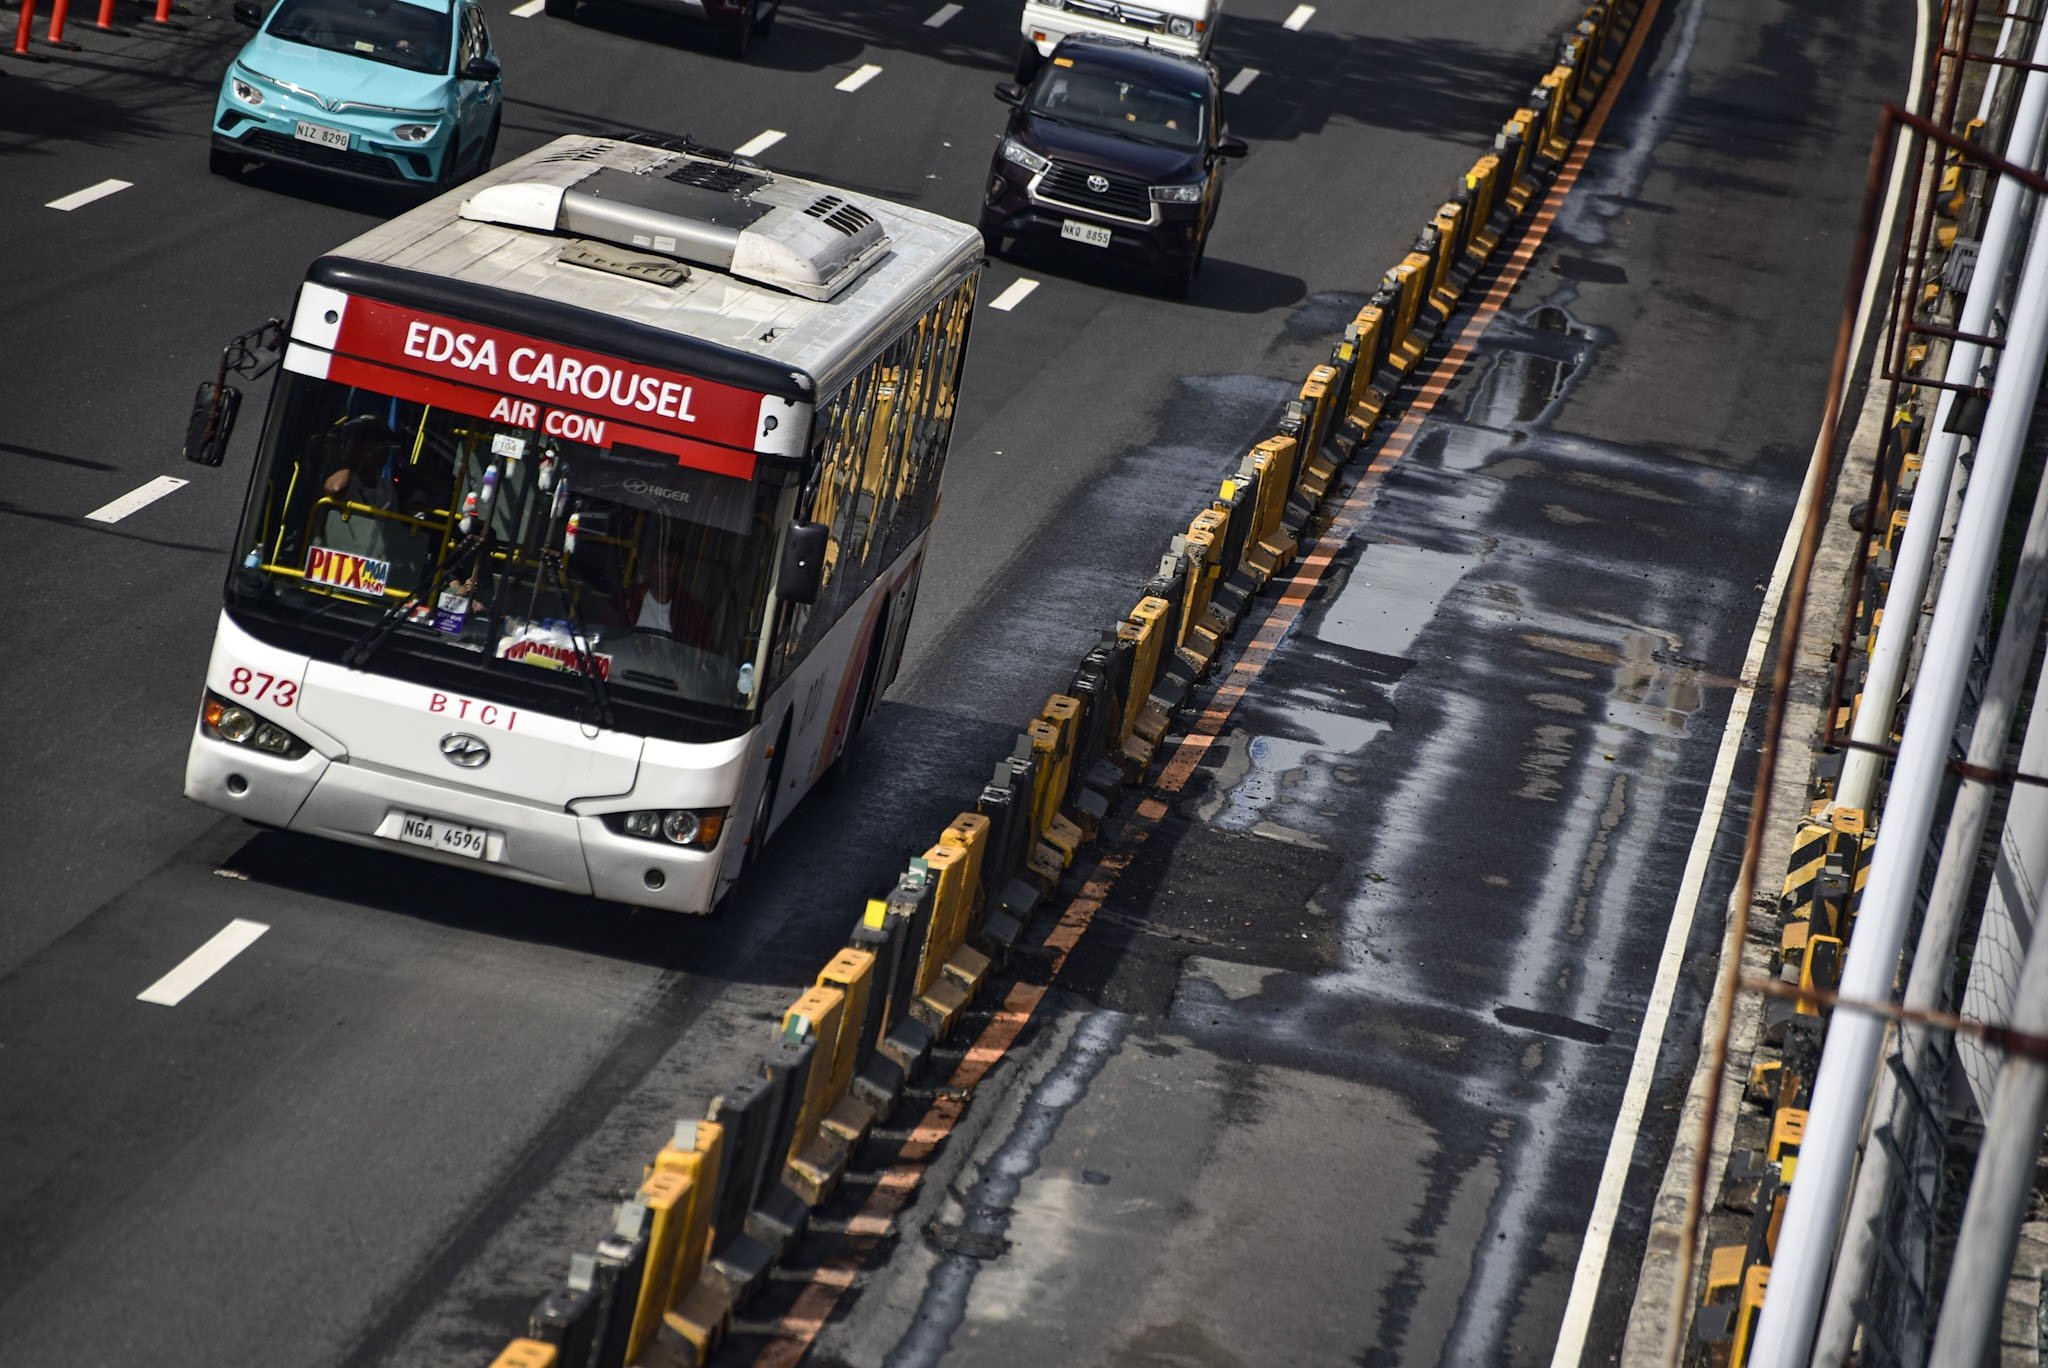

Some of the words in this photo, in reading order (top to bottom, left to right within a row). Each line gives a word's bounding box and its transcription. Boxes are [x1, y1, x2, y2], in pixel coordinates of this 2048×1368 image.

[297, 125, 316, 138] NIZ
[322, 131, 347, 146] 8290
[1063, 225, 1080, 237] NKQ
[1086, 230, 1109, 243] 8855
[403, 321, 498, 376] EDSA
[508, 347, 696, 423] CAROUSEL
[489, 397, 537, 430] AIR
[545, 410, 606, 445] CON
[649, 485, 690, 504] HIGER
[305, 548, 366, 588] PITX
[361, 560, 387, 582] MOA
[229, 667, 298, 708] 873
[404, 820, 433, 841] NGA
[443, 829, 482, 852] 4596
